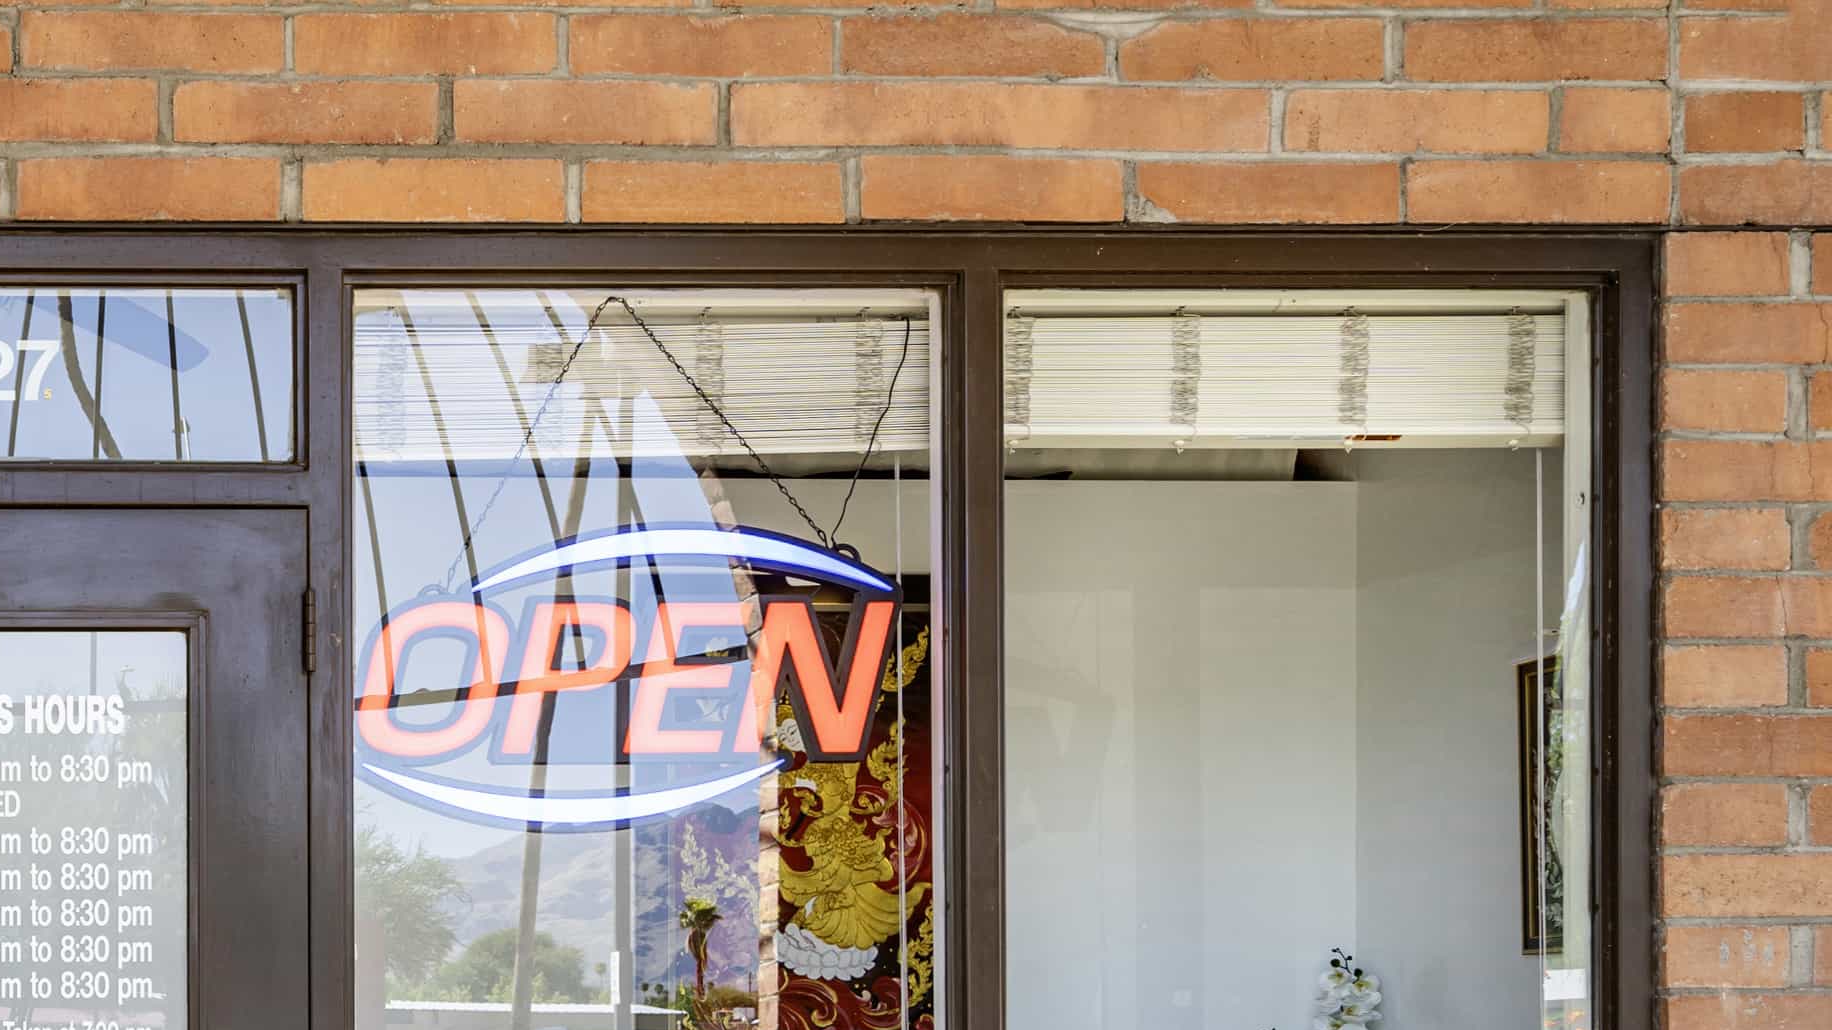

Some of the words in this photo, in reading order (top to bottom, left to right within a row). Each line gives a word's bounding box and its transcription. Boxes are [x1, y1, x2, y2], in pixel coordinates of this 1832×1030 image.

[357, 596, 897, 758] OPEN
[24, 694, 126, 735] HOURS
[30, 755, 52, 782] to
[60, 754, 110, 782] 8:30
[117, 761, 153, 788] pm
[30, 827, 52, 855] to
[60, 826, 110, 855] 8:30
[117, 833, 153, 861] pm
[30, 863, 52, 891] to
[60, 862, 110, 891] 8:30
[117, 869, 153, 897] pm
[30, 900, 52, 926] to
[60, 899, 110, 926] 8:30
[117, 906, 153, 932] pm
[30, 936, 52, 963] to
[60, 935, 110, 963] 8:30
[117, 942, 153, 969] pm
[30, 972, 52, 999] to
[60, 971, 110, 999] 8:30
[117, 978, 153, 1005] pm
